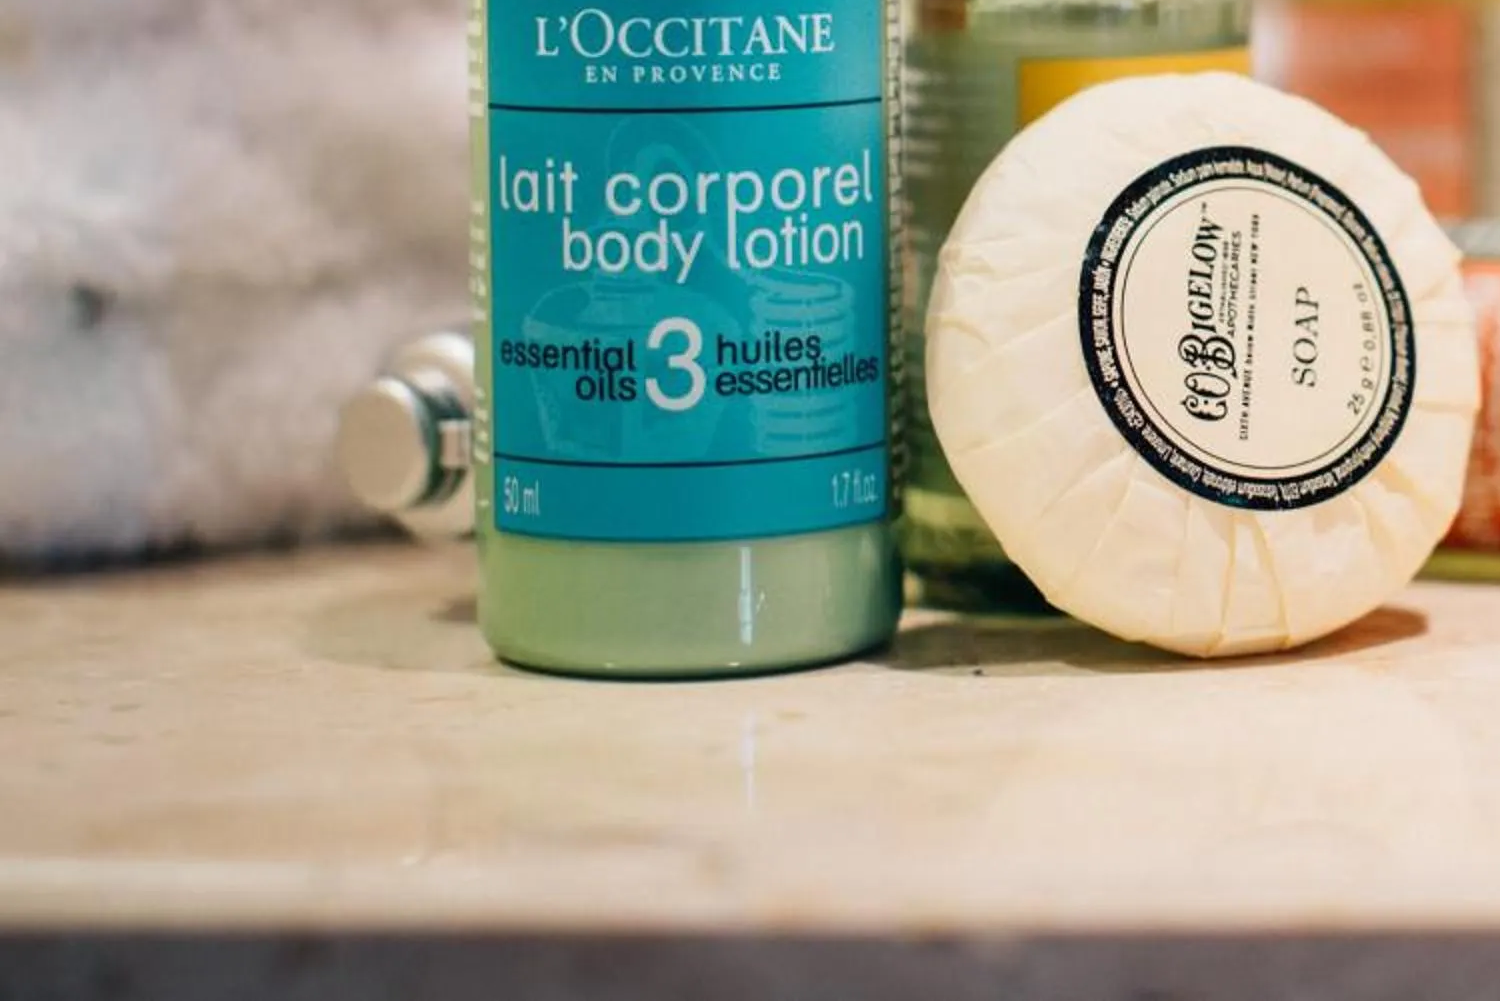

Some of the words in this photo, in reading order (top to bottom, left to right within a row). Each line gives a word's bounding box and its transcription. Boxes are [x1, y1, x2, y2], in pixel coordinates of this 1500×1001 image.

[535, 8, 835, 59] L'OCCITANE
[586, 66, 617, 83] EN
[633, 63, 782, 83] PROVENCE
[499, 155, 578, 214] lait
[605, 149, 874, 239] corporel
[563, 218, 704, 284] body
[727, 213, 864, 270] lotion
[1227, 230, 1243, 339] APOTHECARIES
[501, 338, 636, 372] essential
[716, 332, 822, 364] huiles
[1291, 286, 1320, 388] SOAP
[576, 367, 637, 402] oils
[644, 316, 707, 412] 3
[715, 354, 880, 397] essentielles
[1347, 393, 1366, 415] 25
[504, 477, 519, 515] 50
[522, 482, 540, 516] ml
[832, 473, 850, 509] 1.7
